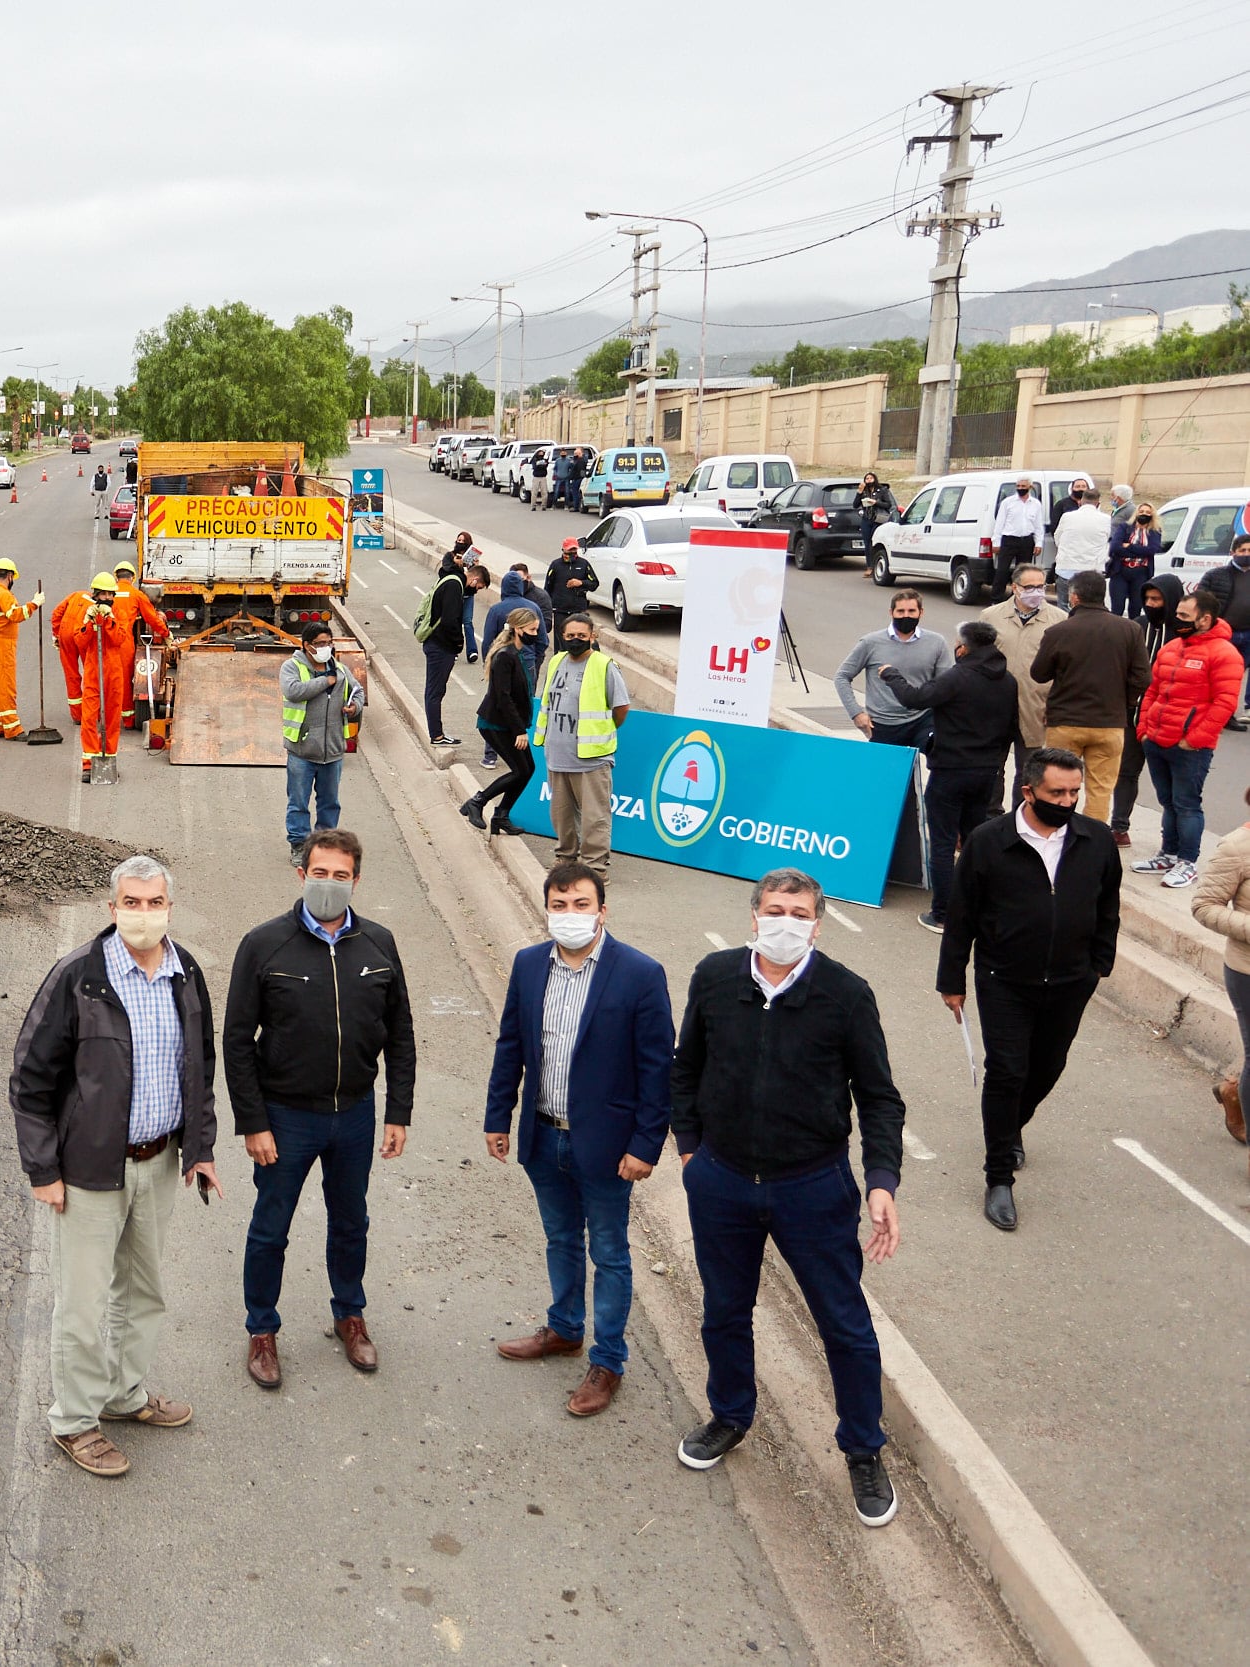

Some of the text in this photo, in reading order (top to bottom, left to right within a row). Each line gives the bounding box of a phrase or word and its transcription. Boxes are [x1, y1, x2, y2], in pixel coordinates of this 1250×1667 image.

[618, 457, 636, 467] 91.3
[644, 457, 662, 466] 91.3
[186, 499, 307, 517] PRECAUCION
[175, 519, 318, 536] VEHICULO LENTO
[709, 645, 749, 674] LH
[707, 672, 747, 684] Las Heras
[718, 815, 851, 860] GOBIERNO
